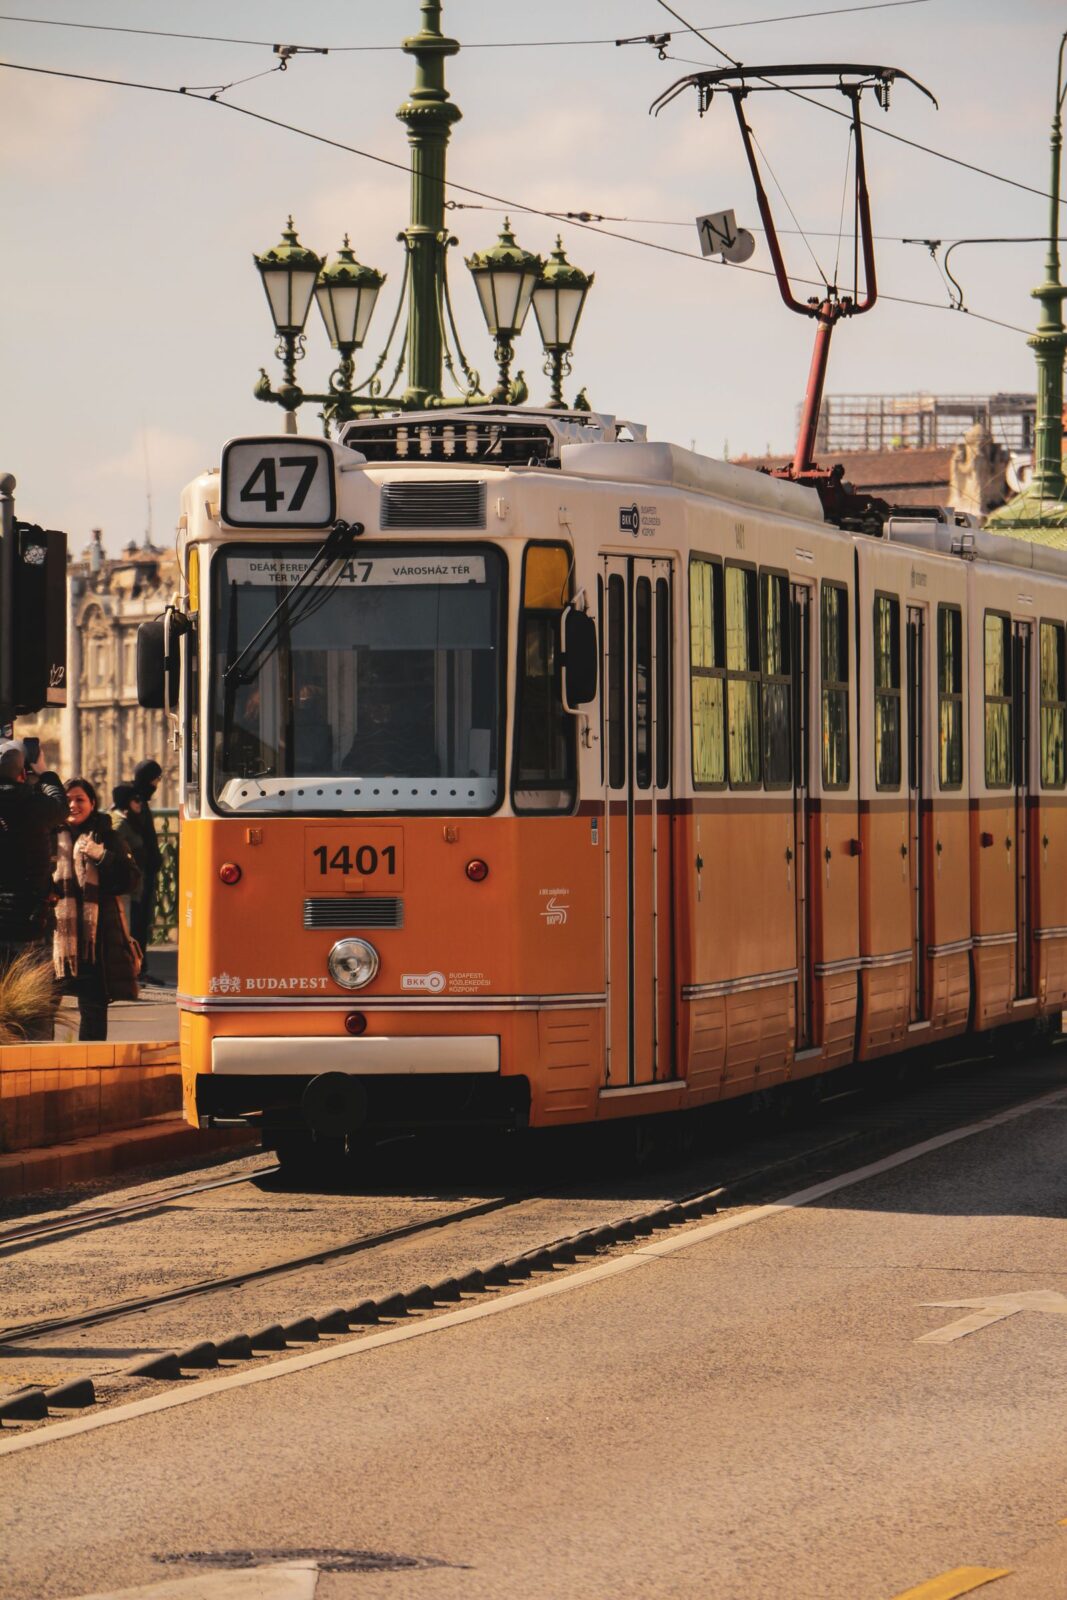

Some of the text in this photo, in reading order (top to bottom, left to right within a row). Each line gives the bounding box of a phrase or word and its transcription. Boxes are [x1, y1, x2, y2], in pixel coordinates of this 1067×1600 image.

[240, 455, 319, 512] 47
[250, 561, 277, 572] DEÁK
[339, 561, 374, 583] 47
[392, 564, 471, 577] VÁROSHÁZ TÉR
[269, 573, 288, 582] TÉR
[313, 845, 397, 875] 1401
[246, 977, 329, 990] BUDAPEST
[406, 978, 426, 986] BKK
